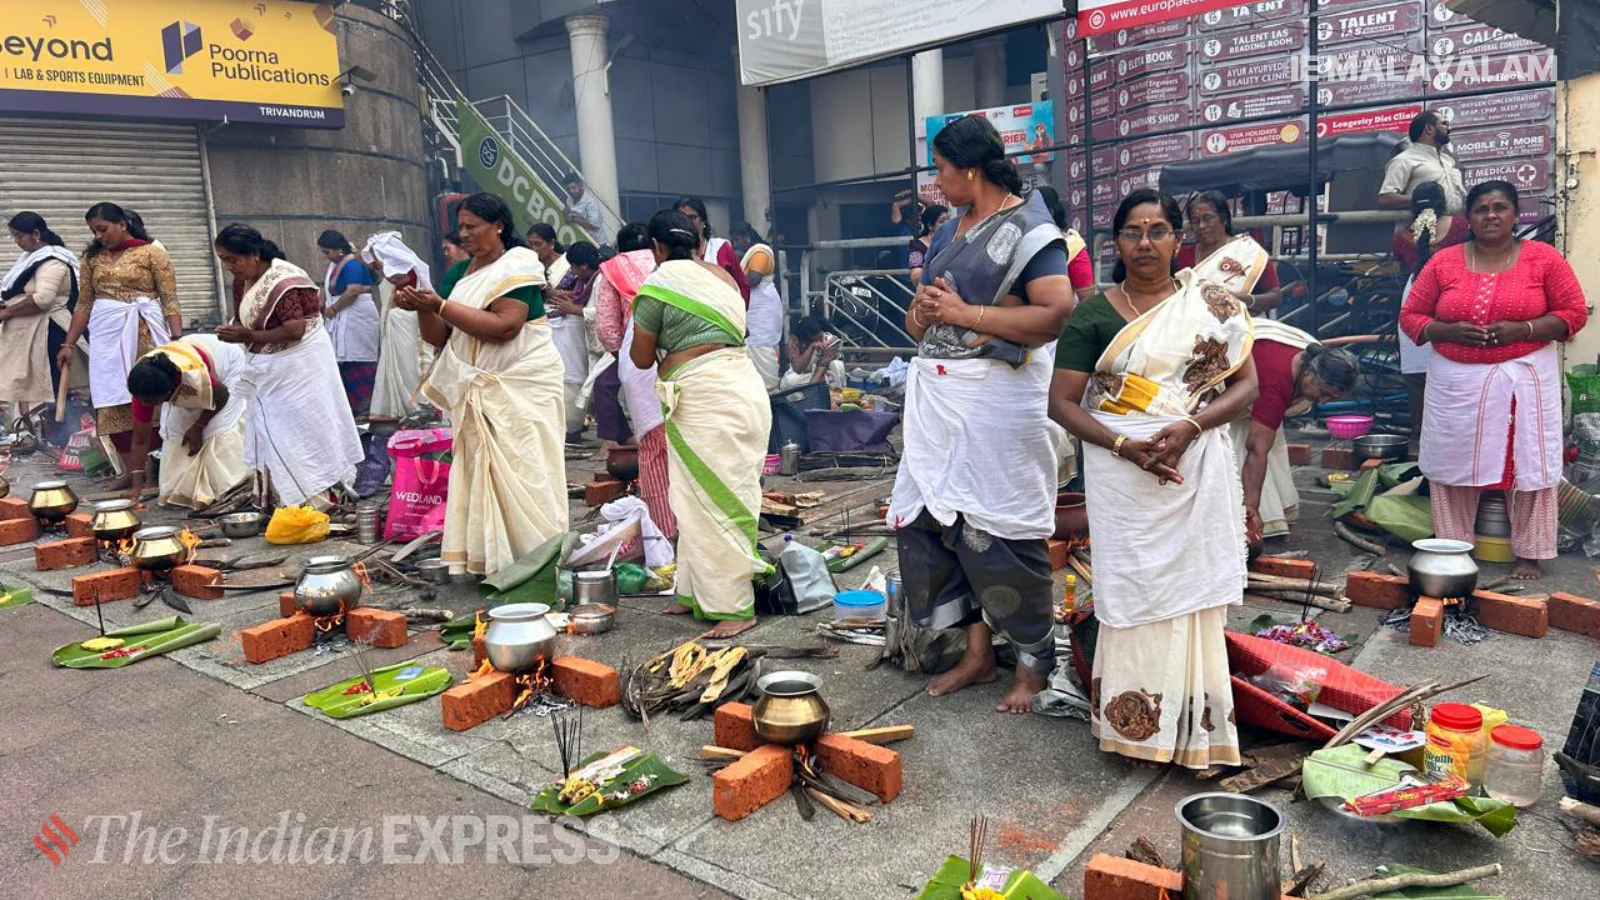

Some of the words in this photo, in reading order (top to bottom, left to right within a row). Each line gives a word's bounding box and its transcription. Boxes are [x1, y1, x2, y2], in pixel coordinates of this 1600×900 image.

[1232, 0, 1285, 17] TAENT
[746, 0, 803, 41] sify
[1339, 10, 1398, 29] TALENT
[1233, 33, 1268, 45] TALENT
[1271, 29, 1289, 39] IAS
[0, 34, 114, 62] eyond
[1229, 42, 1266, 54] READING
[1268, 37, 1293, 47] ROOM
[209, 43, 279, 65] Poorna
[1145, 50, 1173, 64] BOOK
[211, 61, 330, 86] Publications
[1227, 65, 1246, 77] AYUR
[1248, 61, 1290, 75] AYURVEDIC
[13, 67, 34, 80] LAB
[36, 69, 44, 81] &
[46, 69, 86, 84] SPORTS
[88, 72, 145, 87] EQUIPMENT
[1227, 75, 1259, 87] BEAUTY
[1261, 72, 1291, 82] CLINIC
[1488, 94, 1538, 105] CONCENTRATOR
[1500, 104, 1518, 112] SLEEP
[1519, 102, 1540, 110] STUDY
[260, 106, 325, 120] TRIVANDRUM
[1158, 113, 1180, 124] SHOP
[1332, 117, 1373, 129] Longevity
[1375, 114, 1392, 123] Diet
[1003, 132, 1027, 144] RIER
[1227, 138, 1252, 146] PRIVATE
[1254, 134, 1281, 143] LIMITED
[1245, 128, 1277, 137] HOLIDAYS
[1457, 140, 1496, 152] MOBILE
[1500, 139, 1509, 147] N
[1513, 135, 1545, 146] MORE
[1475, 165, 1517, 177] MEDICAL
[496, 157, 530, 203] DC
[526, 189, 578, 246] BOO
[396, 491, 442, 505] WEDLAND
